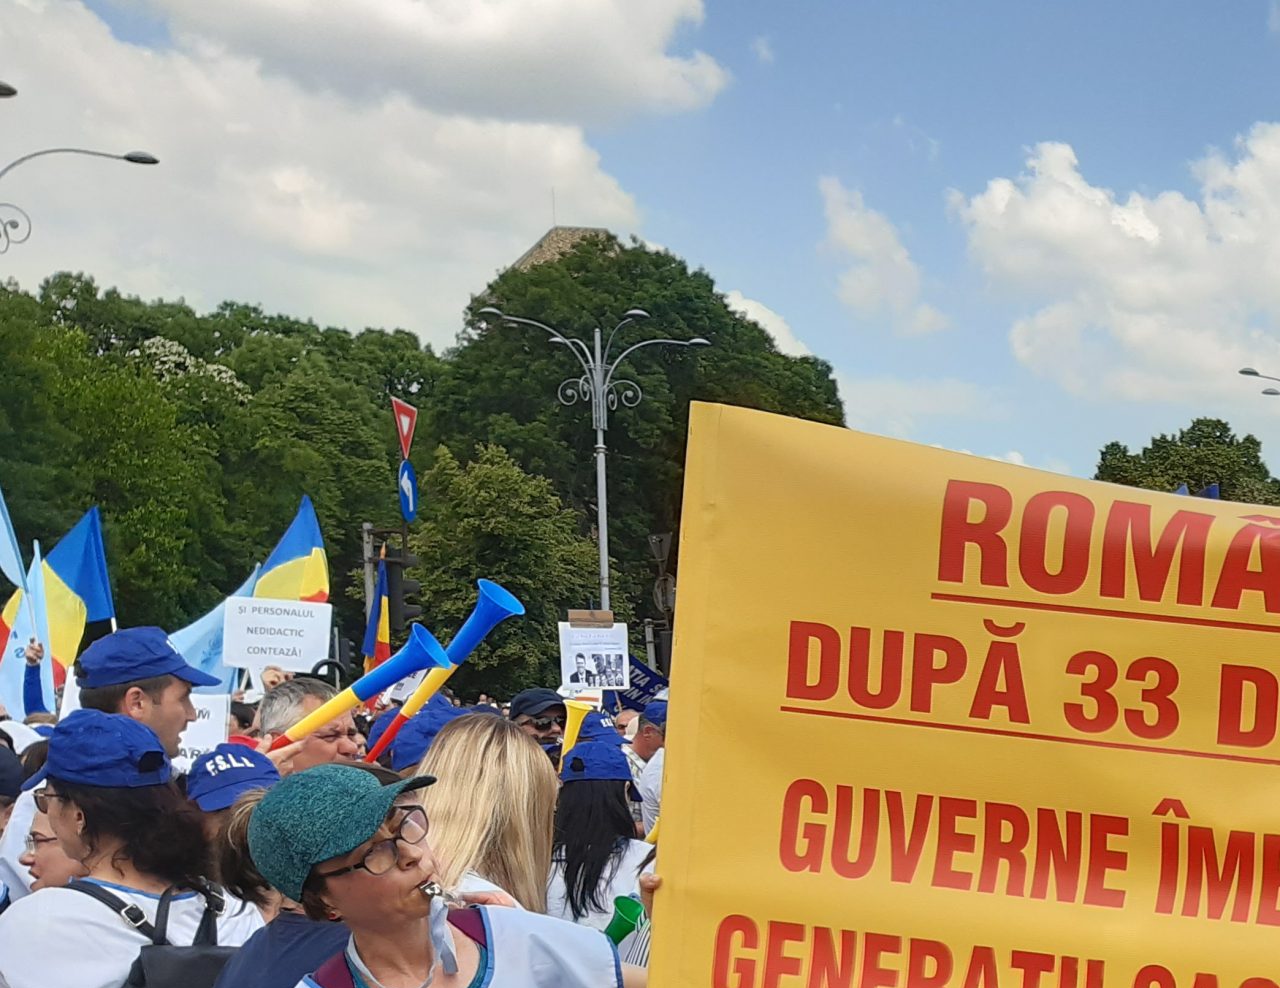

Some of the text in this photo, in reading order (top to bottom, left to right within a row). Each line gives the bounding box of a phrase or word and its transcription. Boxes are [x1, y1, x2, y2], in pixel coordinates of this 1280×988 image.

[247, 627, 304, 638] NEDIDACTIC
[252, 607, 315, 618] PERSONALUL
[787, 620, 1030, 724] DUPĂ
[1064, 652, 1179, 739] 33
[780, 779, 1128, 908] GUVERNE
